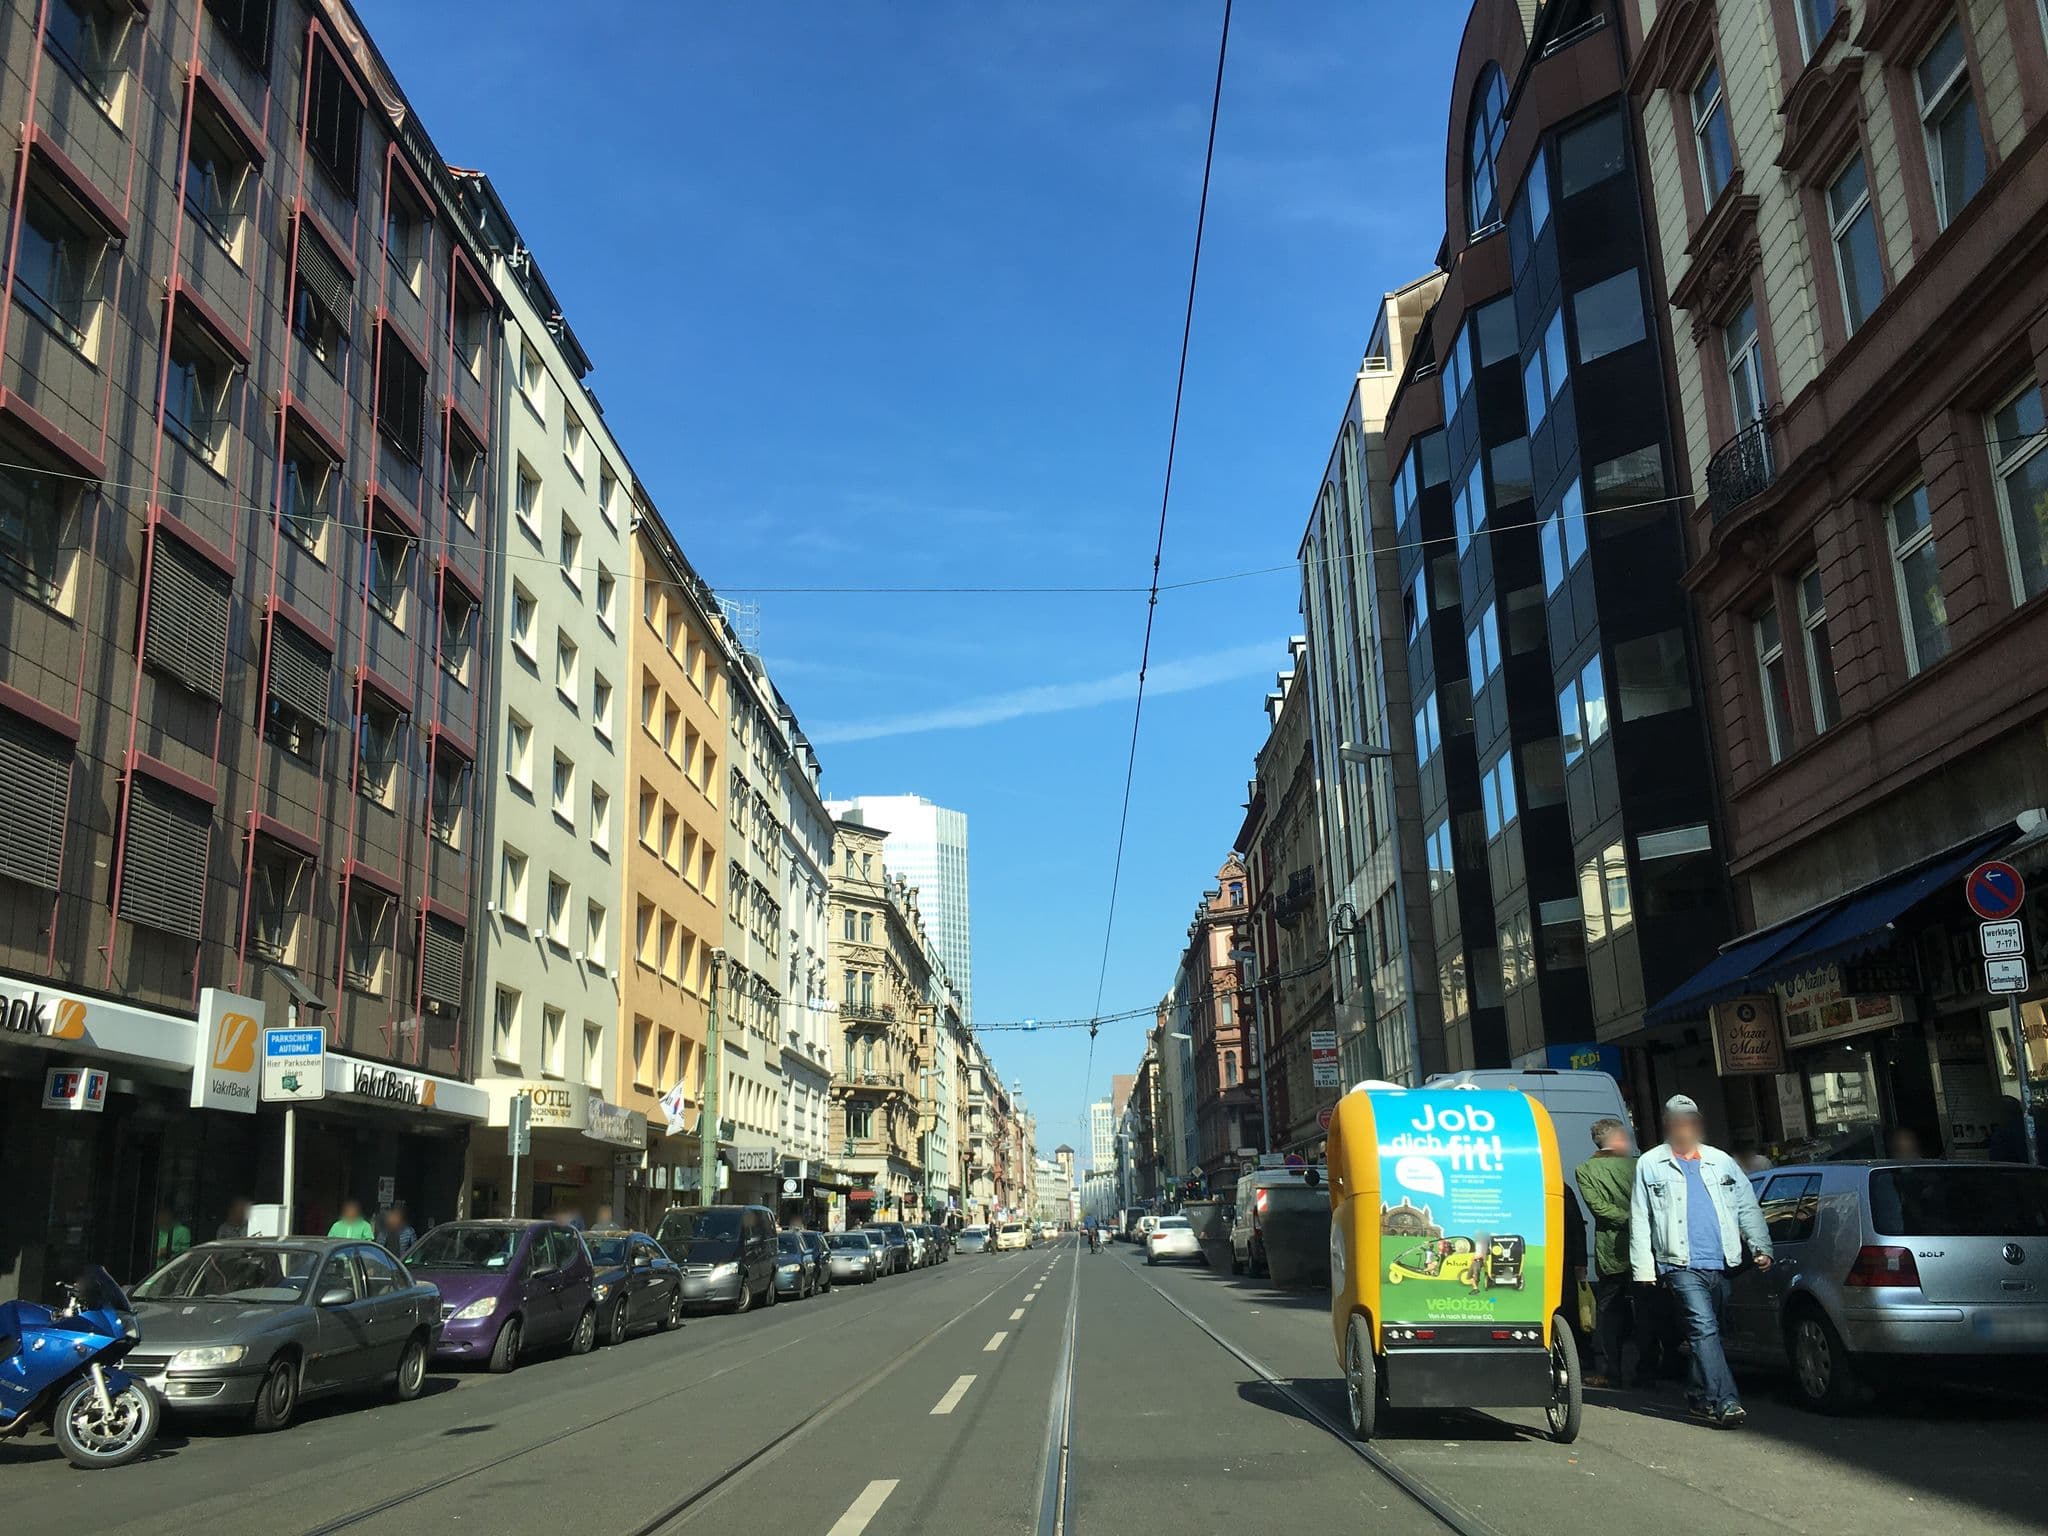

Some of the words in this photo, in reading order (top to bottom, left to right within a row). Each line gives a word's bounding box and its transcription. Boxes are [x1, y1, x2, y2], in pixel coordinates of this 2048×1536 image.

[1986, 928, 2017, 937] werktags
[271, 1033, 317, 1043] PARKSCHEIN-
[1730, 1024, 1767, 1040] Nazar
[279, 1044, 310, 1053] AUTOMAT
[267, 1059, 281, 1068] Hier
[284, 1057, 321, 1067] Parkschein
[1411, 1104, 1496, 1132] Job
[1391, 1133, 1443, 1151] dich
[1447, 1135, 1504, 1171] fit!
[739, 1151, 770, 1169] HOTEL
[1425, 1297, 1496, 1311] velotaxi
